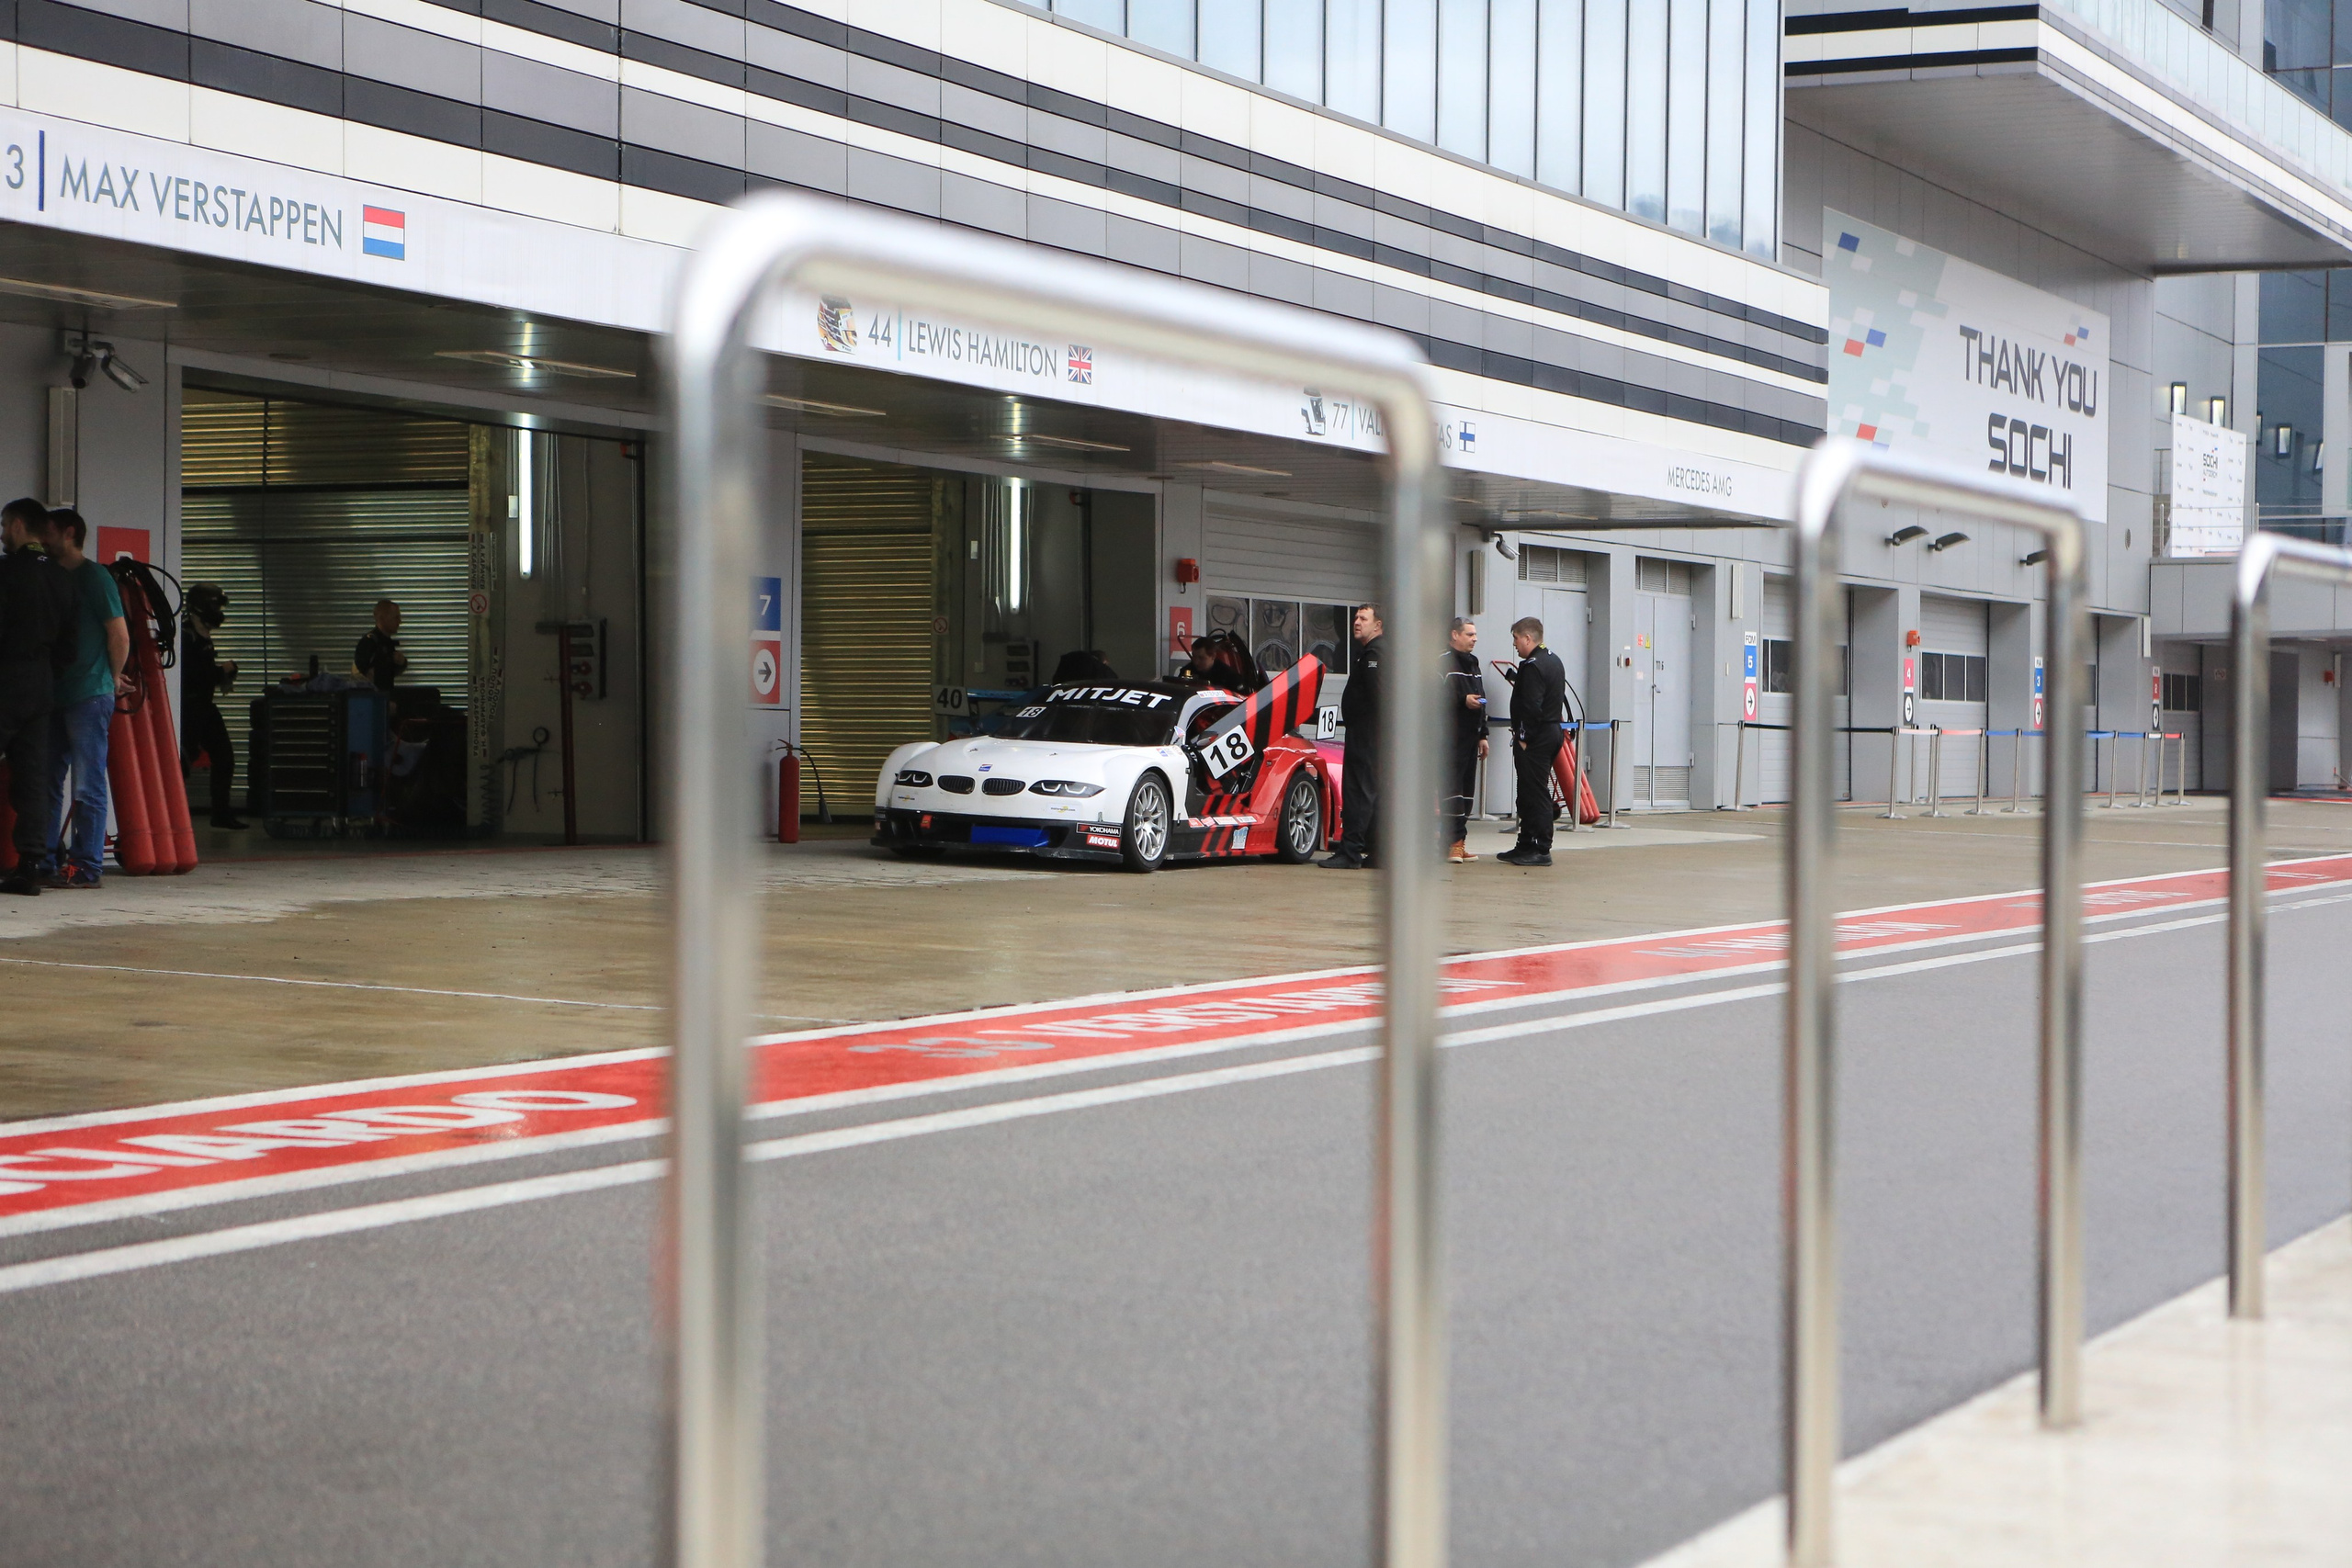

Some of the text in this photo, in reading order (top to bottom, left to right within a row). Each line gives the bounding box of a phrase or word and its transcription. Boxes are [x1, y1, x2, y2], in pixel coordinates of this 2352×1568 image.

[6, 144, 342, 249] 3 MAX VERSTAPPEN
[868, 313, 1057, 378] 44 LEWIS HAMILTON
[1959, 324, 2098, 418] THANK YOU
[1333, 402, 1349, 430] 77
[1988, 412, 2072, 490] SOCHI
[2203, 453, 2218, 469] SOCHI
[1668, 466, 1733, 497] MERCEDES AMG
[759, 595, 771, 615] 7
[1177, 621, 1185, 638] 6
[1747, 655, 1753, 669] 5
[1906, 668, 1911, 680] 4
[936, 687, 962, 709] 40
[1046, 687, 1172, 708] MITJET
[1021, 707, 1042, 716] 18
[1321, 710, 1334, 733] 18
[1209, 732, 1248, 771] 18
[1089, 826, 1119, 835] YOKOHAMA
[1089, 836, 1118, 847] MOTUL
[847, 1036, 1055, 1059] 33
[0, 1089, 638, 1194] CIARDO
